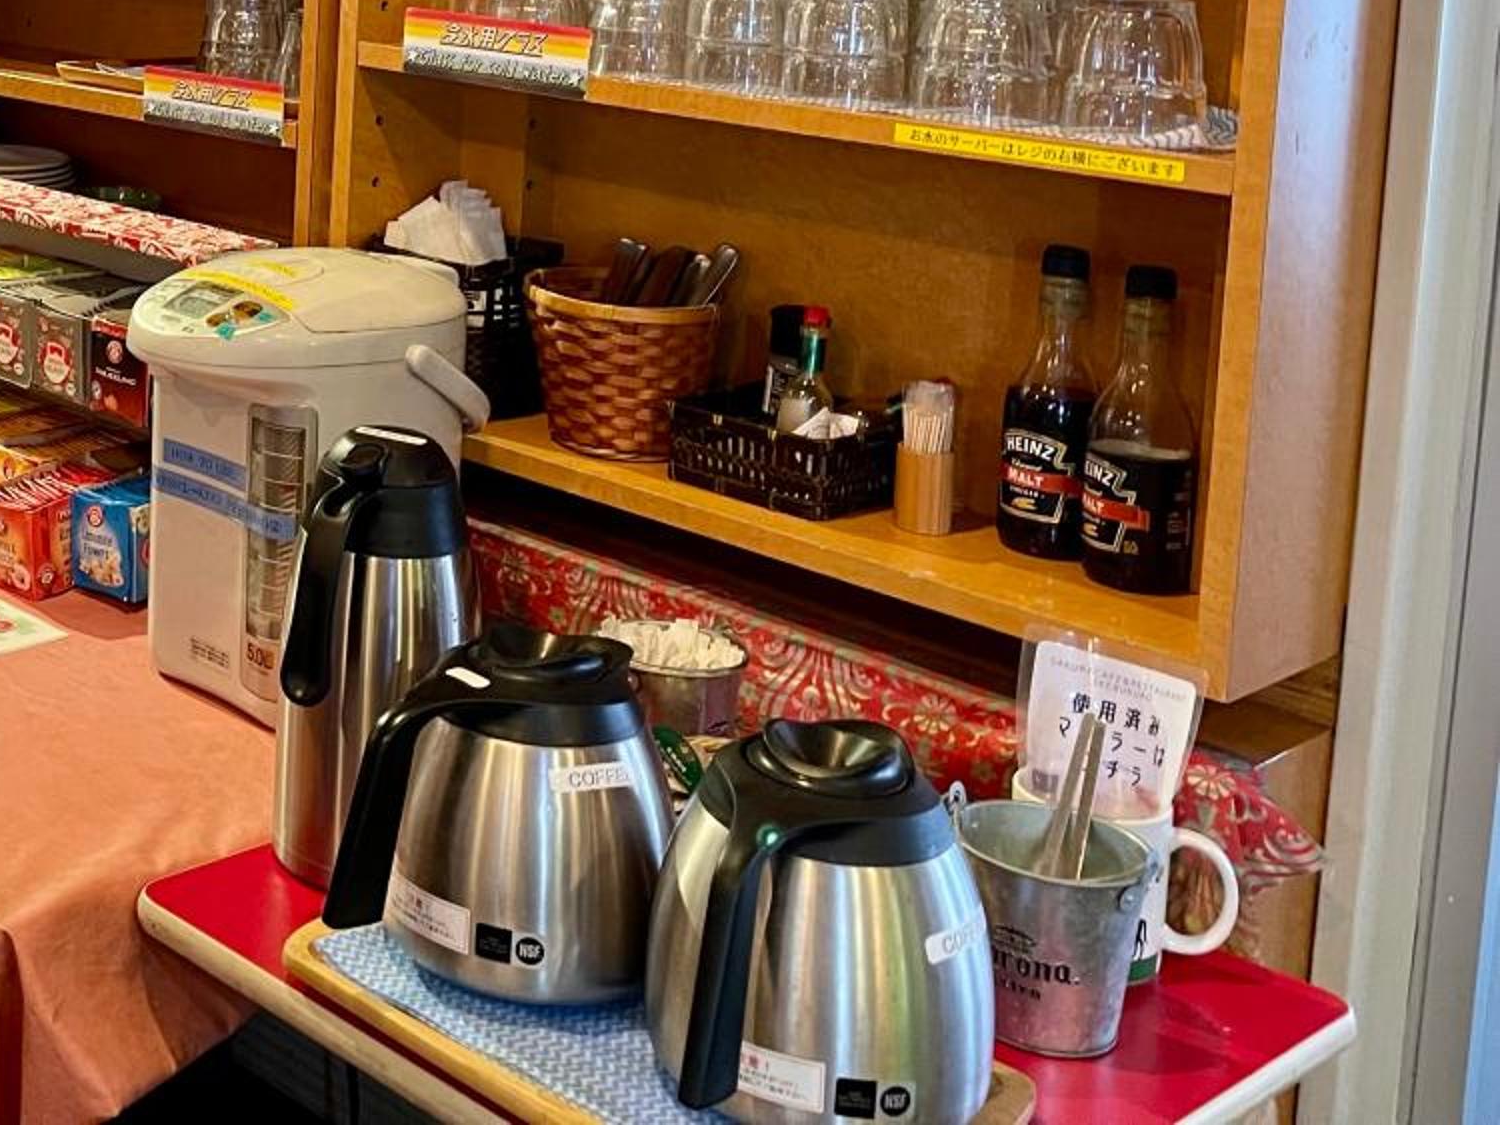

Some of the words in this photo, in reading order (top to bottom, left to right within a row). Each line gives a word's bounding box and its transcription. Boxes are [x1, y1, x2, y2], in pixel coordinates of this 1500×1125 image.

[1007, 436, 1055, 462] HEINZ
[1007, 464, 1045, 488] MALT
[1072, 691, 1161, 737] 使用済み
[1059, 716, 1166, 768] マラーは
[519, 943, 542, 959] NSF
